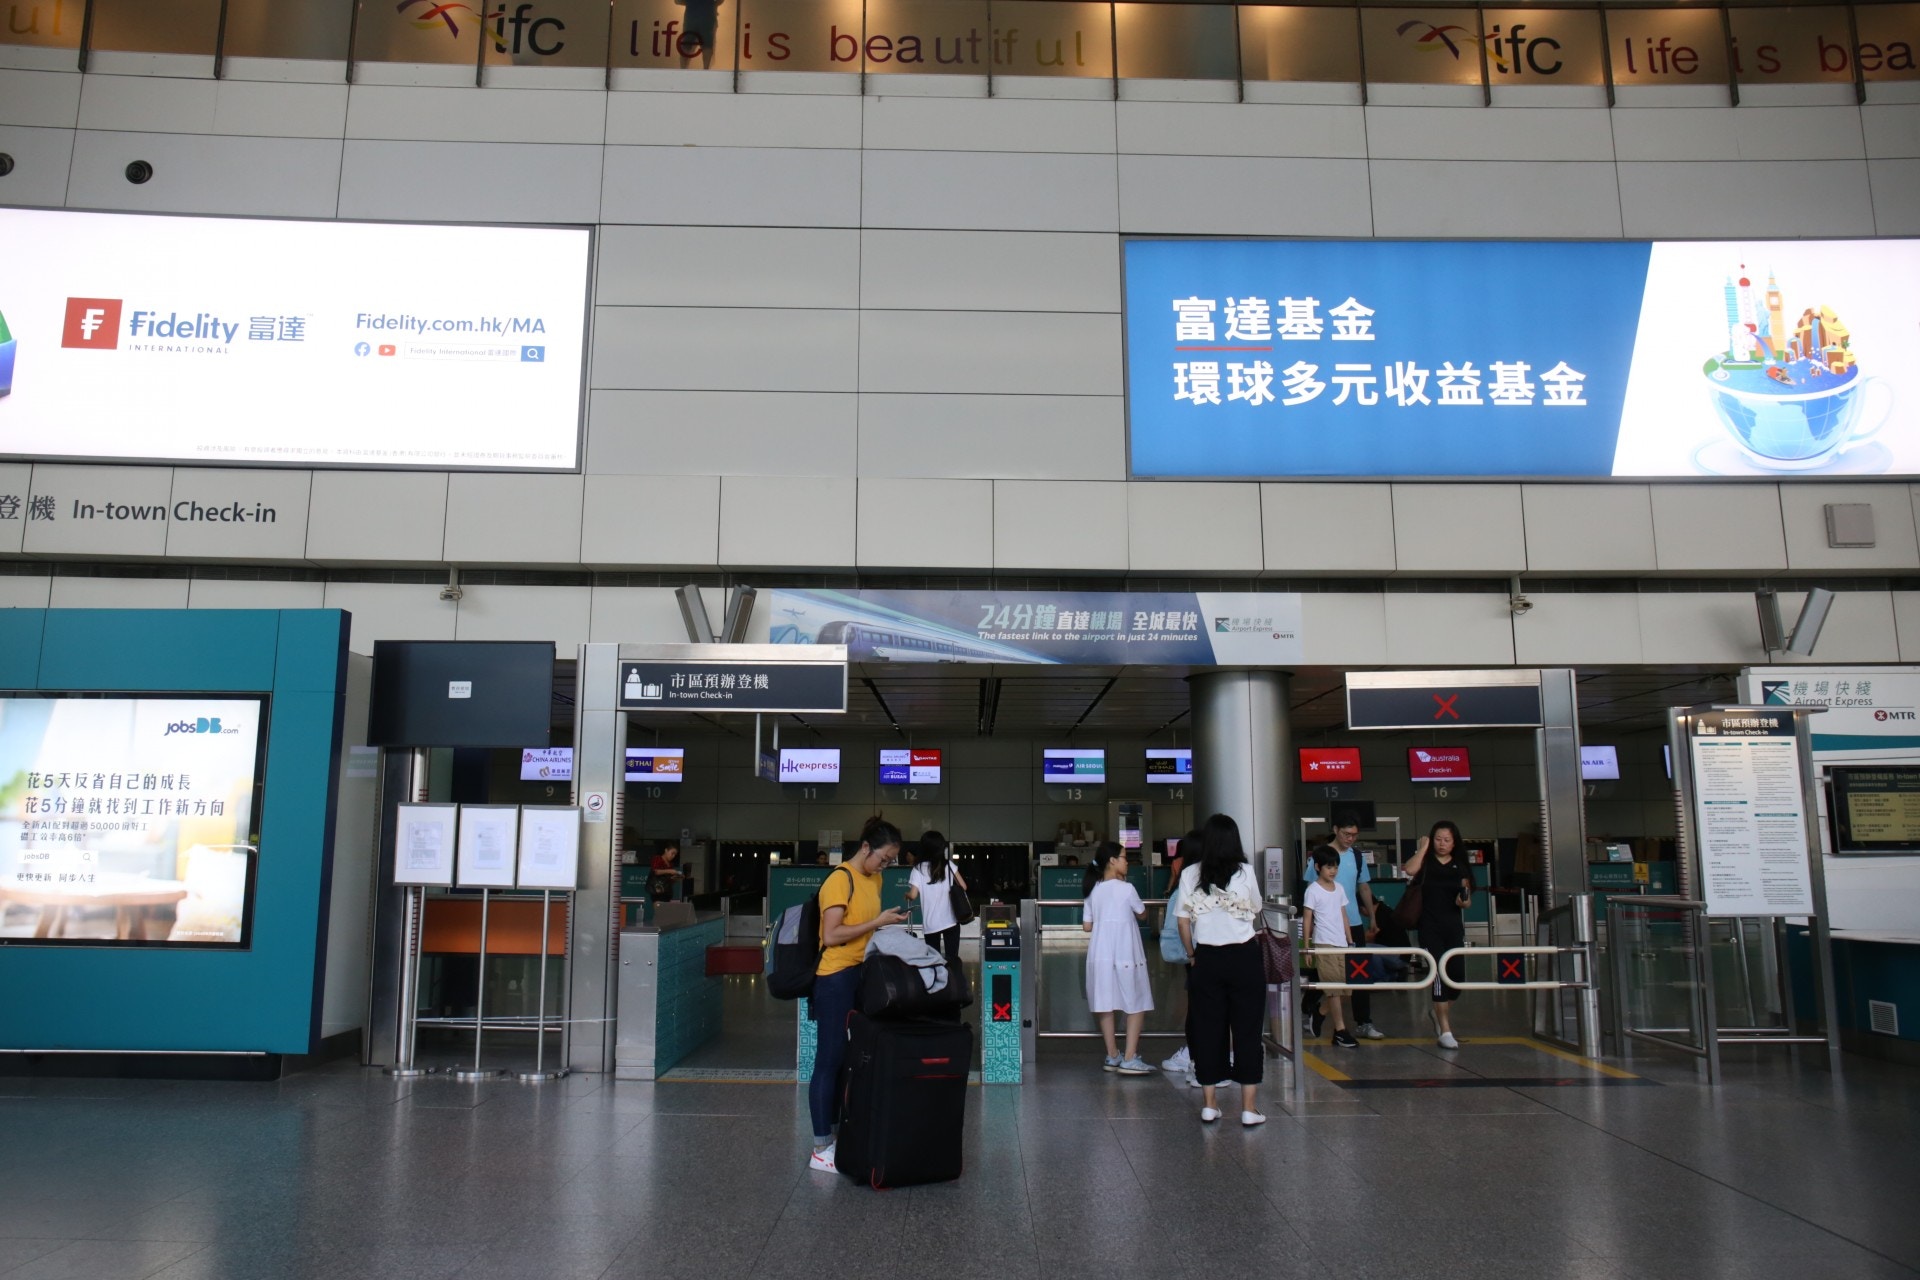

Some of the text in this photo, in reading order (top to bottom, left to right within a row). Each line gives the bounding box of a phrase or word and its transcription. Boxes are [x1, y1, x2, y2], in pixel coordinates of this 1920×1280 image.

[495, 4, 566, 56] ifc
[630, 20, 703, 58] life
[743, 23, 791, 60] is
[1493, 24, 1563, 75] ifc
[1625, 37, 1699, 75] life
[1733, 38, 1781, 73] is
[356, 313, 546, 337] Fidelity.com.hk/MA
[1172, 296, 1376, 342] 富達基金
[129, 311, 306, 344] Fidelity 富達
[129, 344, 229, 354] INTERNATIONAL
[410, 347, 437, 356] Fidelity
[439, 348, 486, 356] International
[1173, 361, 1587, 407] 環球多元收益基金
[73, 499, 167, 521] In-town
[173, 501, 276, 522] Check-in
[1132, 611, 1198, 631] 全城最快
[978, 632, 1198, 643] The fastest link to the airport in just 24 minutes
[670, 673, 769, 690] 市區預辦登機
[669, 691, 733, 699] In-town Check-in
[1795, 697, 1873, 707] Airport Express
[1889, 711, 1916, 720] MTR
[1721, 718, 1779, 728] 市區預辦登機
[27, 772, 191, 790] 花5天反省自己的成長
[545, 786, 554, 797] 9
[645, 786, 661, 798] 10
[803, 788, 817, 799] 11
[902, 788, 918, 800] 12
[1066, 788, 1082, 800] 13
[1168, 788, 1185, 800] 14
[1323, 786, 1338, 798] 15
[1432, 786, 1448, 798] 16
[25, 797, 225, 817] 花5分鐘就找到工作新方向
[24, 852, 50, 860] jobsDB
